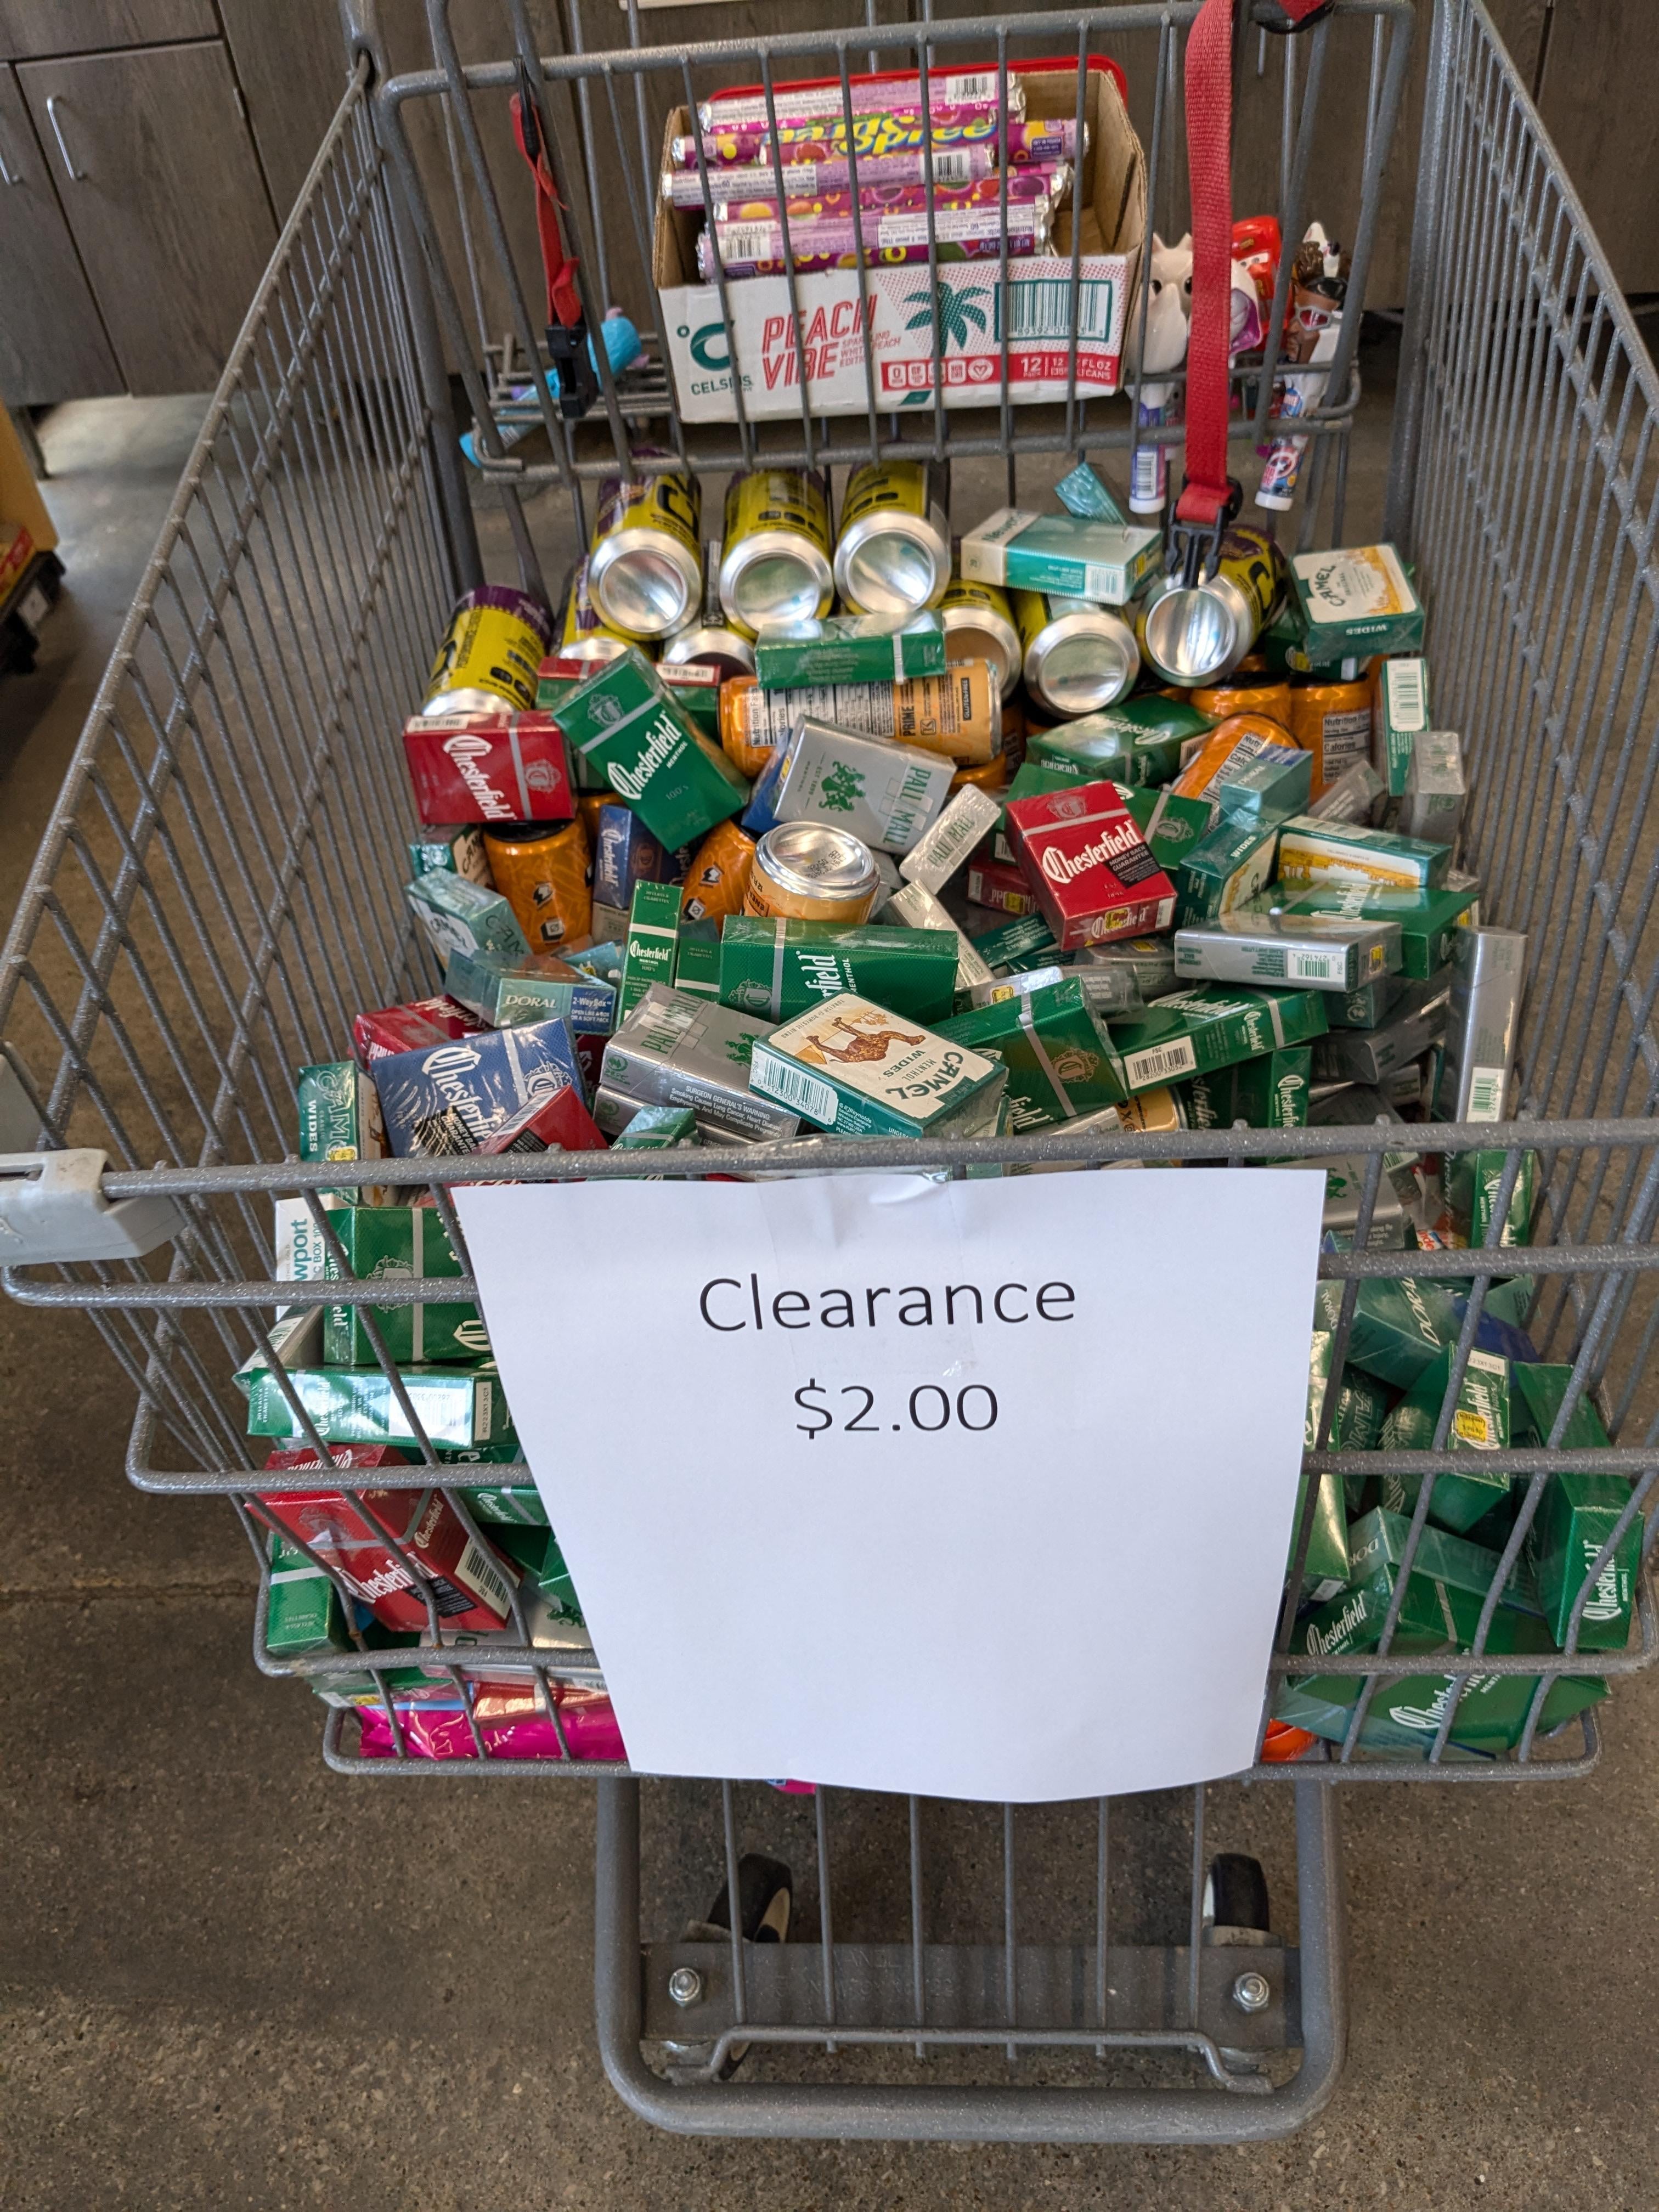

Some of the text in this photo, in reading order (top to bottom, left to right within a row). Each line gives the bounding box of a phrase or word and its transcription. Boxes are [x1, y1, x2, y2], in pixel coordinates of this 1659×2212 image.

[762, 342, 839, 391] VIBE
[1021, 357, 1041, 373] 12
[1315, 565, 1346, 607] CAMEL
[1346, 625, 1387, 635] WIDES
[752, 708, 761, 745] Nutrition
[902, 706, 916, 736] PRIME
[607, 709, 682, 800] Chesterfield
[666, 741, 688, 769] MENTHOL
[443, 735, 513, 821] Chesterfield
[900, 766, 931, 802] PALL
[883, 809, 916, 845] MALL
[927, 814, 975, 867] PALL MALL
[1042, 820, 1142, 884] Chesterfield
[1109, 845, 1147, 866] MONEY BACK
[1113, 850, 1149, 872] GUARANTEE
[1230, 836, 1256, 858] WIDES
[630, 940, 672, 961] Chesterfield
[505, 995, 557, 1009] DORAL
[826, 998, 846, 1013] TURKISH
[781, 1026, 797, 1039] BLEND
[795, 1014, 820, 1032] DOMESTIC
[640, 1024, 681, 1054] PALL
[883, 1049, 926, 1077] WIDES
[884, 1050, 964, 1100] CAMEL
[901, 1058, 936, 1081] MENTHOL
[669, 1093, 701, 1110] Emphysema,
[702, 1105, 713, 1114] And
[714, 1109, 725, 1119] May
[726, 1114, 754, 1129] Complicate
[671, 1087, 693, 1101] Smoking
[694, 1096, 713, 1108] Causes
[713, 1103, 726, 1113] Lung
[727, 1108, 745, 1120] Cancer,
[747, 1114, 761, 1124] Heart
[685, 1086, 771, 1121] SURGEON GENERAL'S WARNING:
[771, 1085, 793, 1102] 12300
[795, 1098, 819, 1116] 34078
[843, 1104, 872, 1124] RJReynolds
[308, 1099, 318, 1152] WIDES
[838, 1107, 872, 1129] Tobacco Company
[290, 1217, 312, 1282] wport
[313, 1242, 322, 1263] BOX
[698, 1273, 1076, 1331] Clearance
[794, 1378, 999, 1440] $2.00
[1306, 1589, 1368, 1656] Chesterfield
